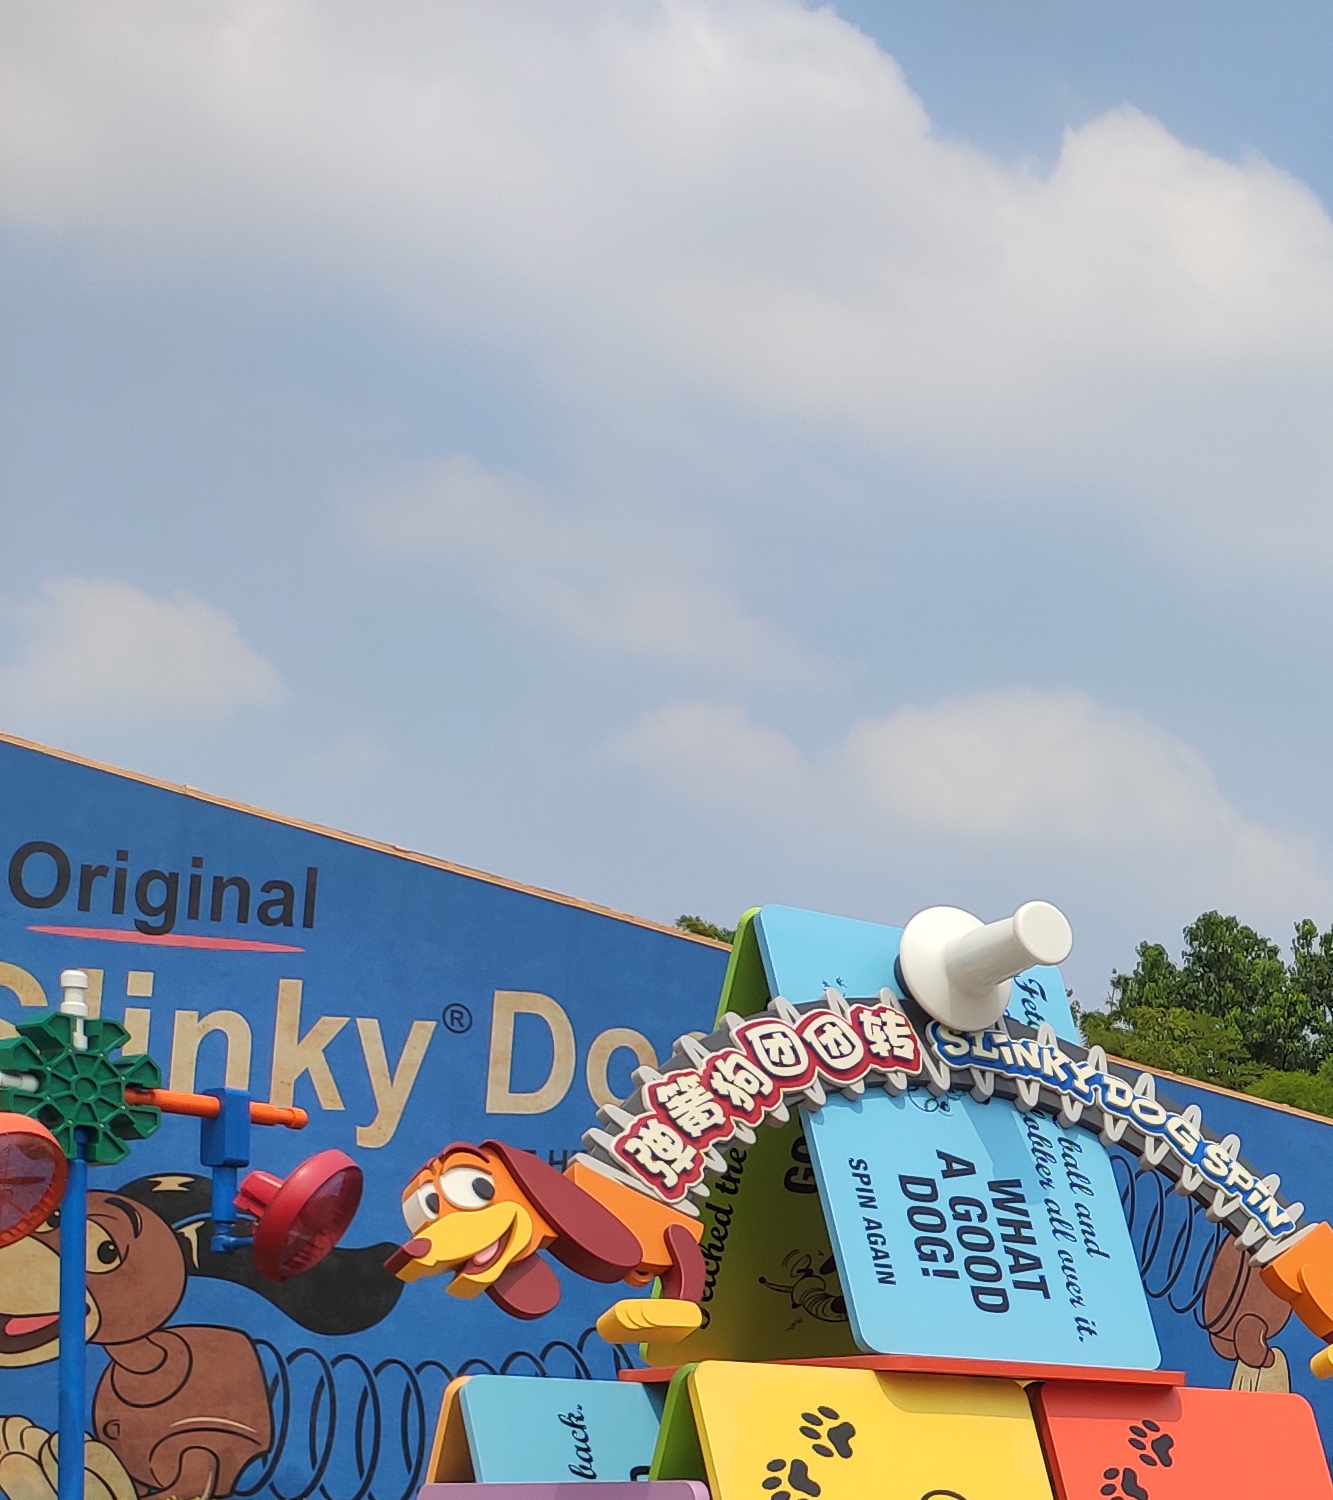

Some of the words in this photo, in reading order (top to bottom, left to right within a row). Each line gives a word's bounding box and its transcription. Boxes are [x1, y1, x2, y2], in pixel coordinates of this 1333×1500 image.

[8, 841, 319, 934] Original
[485, 989, 708, 1115] Do
[624, 1009, 916, 1189] 弹簧狗团团转
[1102, 1075, 1201, 1155] DOG
[848, 1157, 878, 1210] SPIN
[936, 1149, 977, 1179] A
[1023, 1109, 1057, 1190] lobber
[1058, 1137, 1094, 1196] ball
[862, 1216, 896, 1285] AGAIN
[899, 1174, 960, 1280] DOG!
[948, 1196, 1010, 1314] GOOD
[987, 1179, 1051, 1300] WHAT
[1044, 1197, 1077, 1242] all
[1075, 1202, 1111, 1260] and
[1058, 1250, 1087, 1309] over
